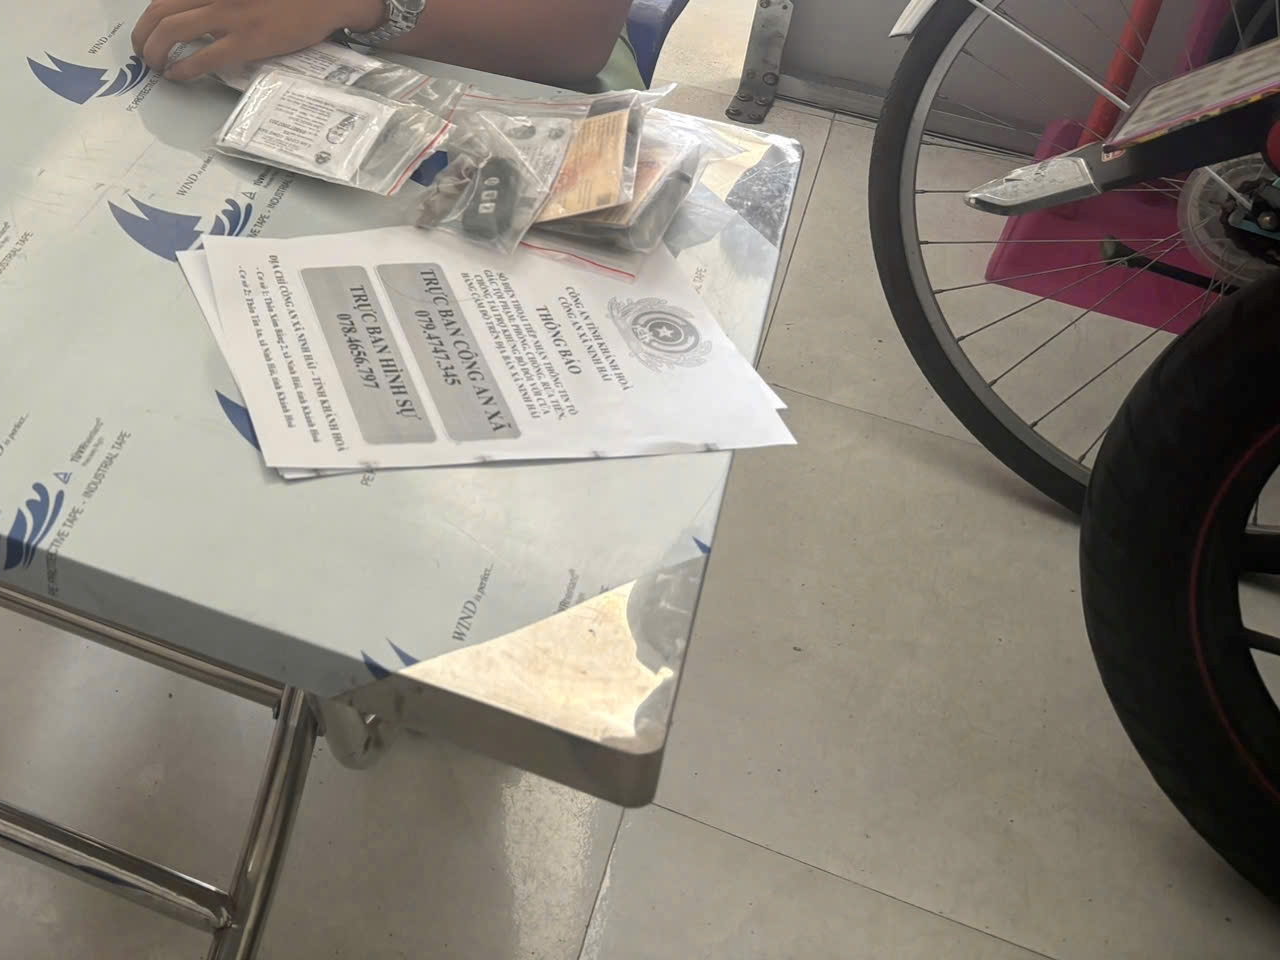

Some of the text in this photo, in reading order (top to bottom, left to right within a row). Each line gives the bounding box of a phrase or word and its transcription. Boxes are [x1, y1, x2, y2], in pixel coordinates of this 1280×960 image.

[87, 36, 109, 55] WIND
[126, 78, 158, 112] PE PROTECTIVE
[176, 173, 199, 197] WIND
[253, 177, 293, 233] TAPE INDUSTRIAL
[15, 231, 34, 252] TAPE
[692, 267, 707, 283] TAPE
[287, 308, 298, 320] AN
[297, 332, 311, 353] NINH
[579, 310, 590, 321] AN
[335, 312, 380, 389] 078.4656.797
[349, 284, 422, 421] TRỰC BAN HÌNH SỰ
[413, 309, 462, 386] 079.4747.345
[419, 268, 512, 432] TRỰC BAN CÔNG AN XÃ
[535, 305, 582, 375] THÔNG BÁO
[571, 320, 583, 331] AN
[586, 344, 603, 365] NINH
[62, 507, 84, 529] TAPE
[83, 453, 118, 499] INDUSTRIAL
[114, 431, 132, 455] TAPE
[452, 599, 480, 643] WIND
